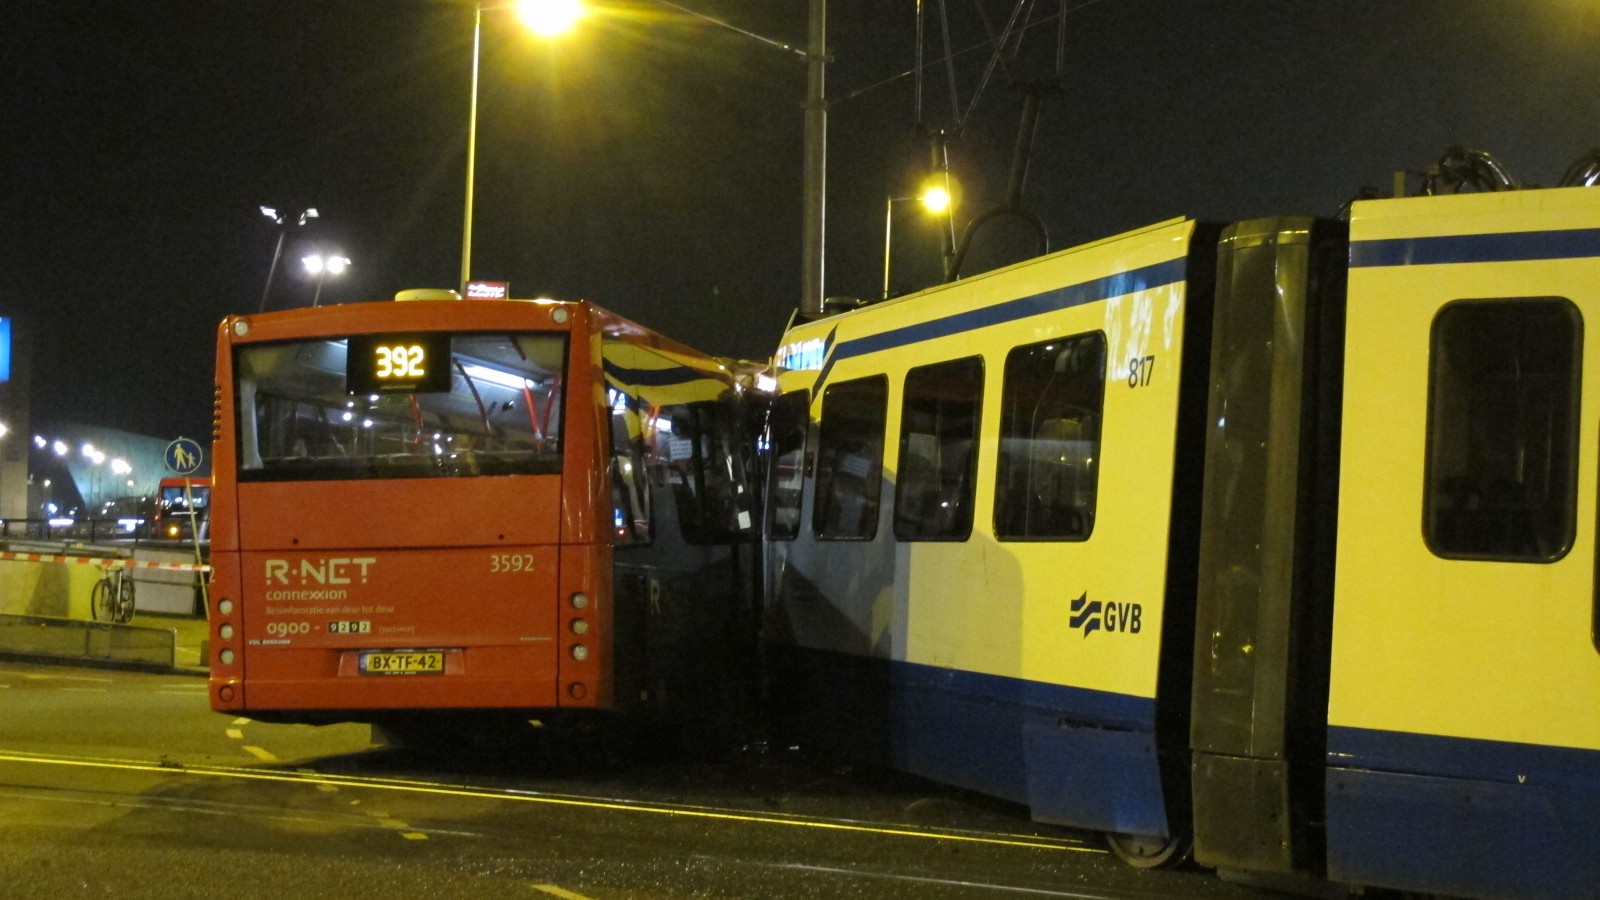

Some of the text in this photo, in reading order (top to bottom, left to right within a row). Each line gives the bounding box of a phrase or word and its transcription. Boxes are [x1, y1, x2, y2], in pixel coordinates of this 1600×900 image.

[376, 345, 425, 377] 392
[1128, 355, 1155, 389] 817
[490, 554, 535, 573] 3592
[265, 589, 347, 601] connexxion
[361, 605, 374, 613] tot
[375, 604, 395, 613] deur
[1104, 601, 1142, 634] GVB
[266, 622, 310, 637] 0900
[329, 621, 371, 633] 9292
[373, 655, 436, 669] BX-TF-42
